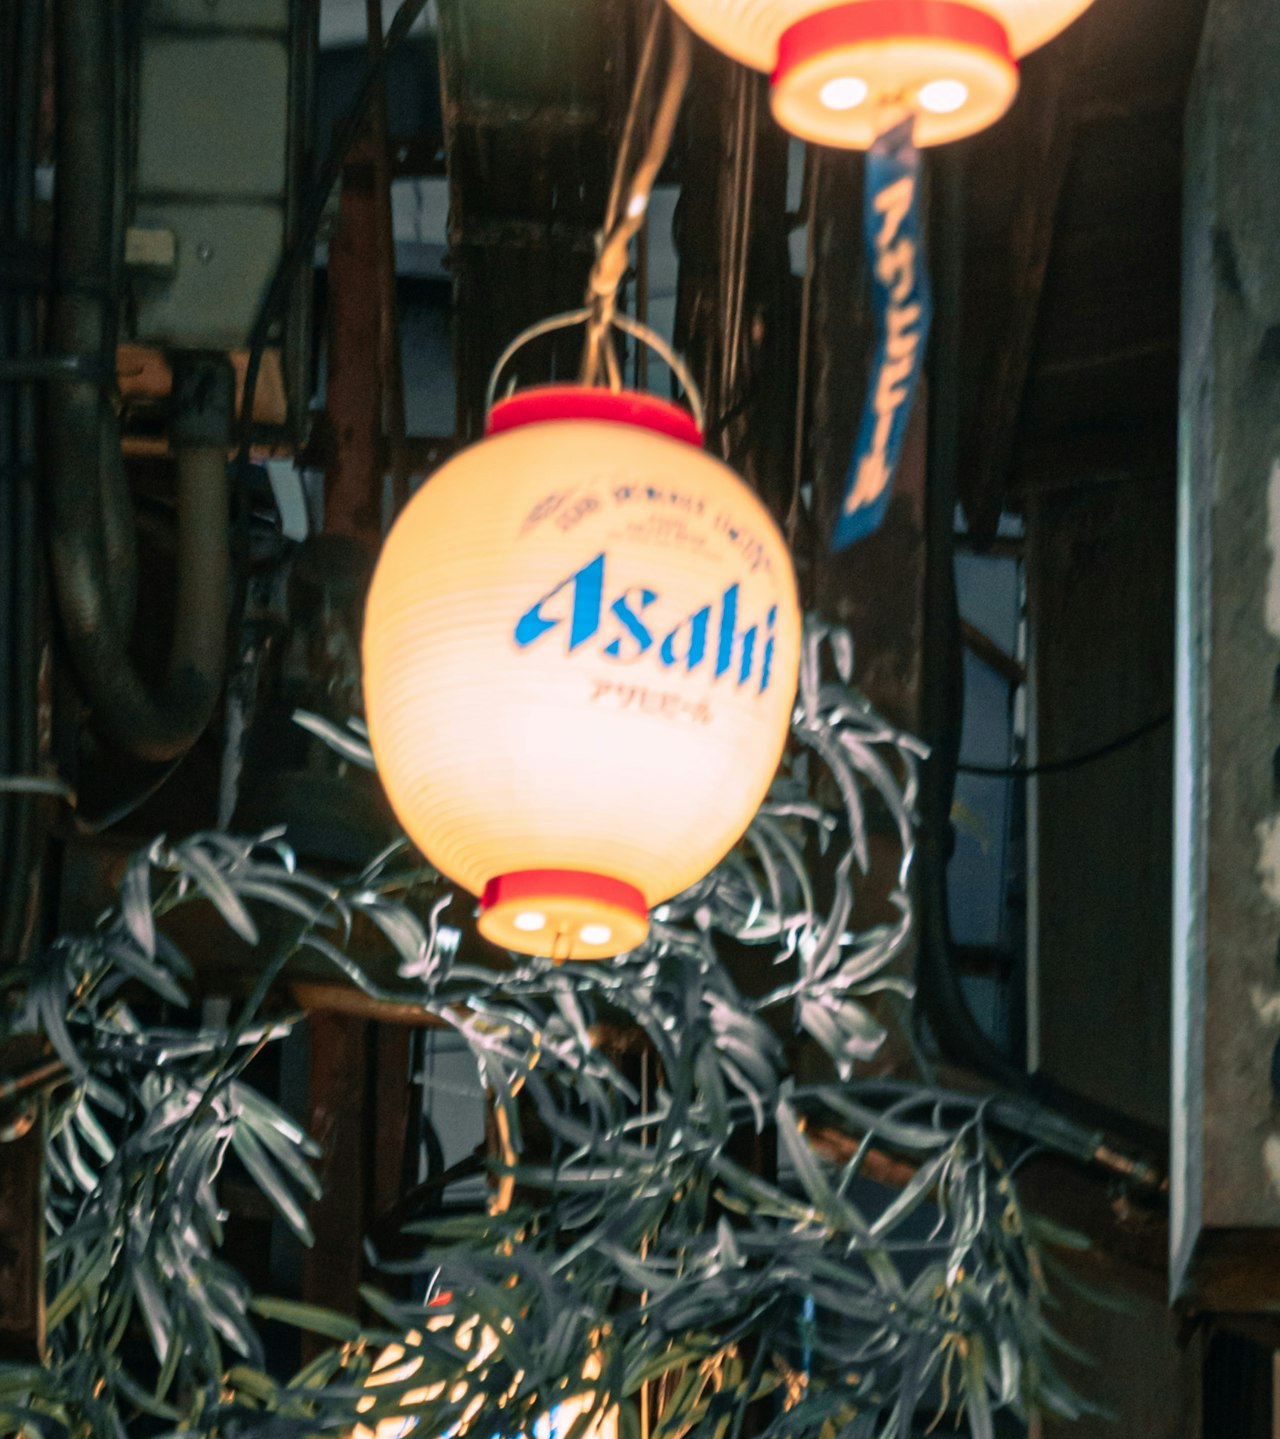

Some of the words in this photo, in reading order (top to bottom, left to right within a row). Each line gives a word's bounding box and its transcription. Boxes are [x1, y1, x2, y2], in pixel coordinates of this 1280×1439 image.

[510, 552, 780, 696] Asahi
[589, 677, 714, 727] アサヒビール
